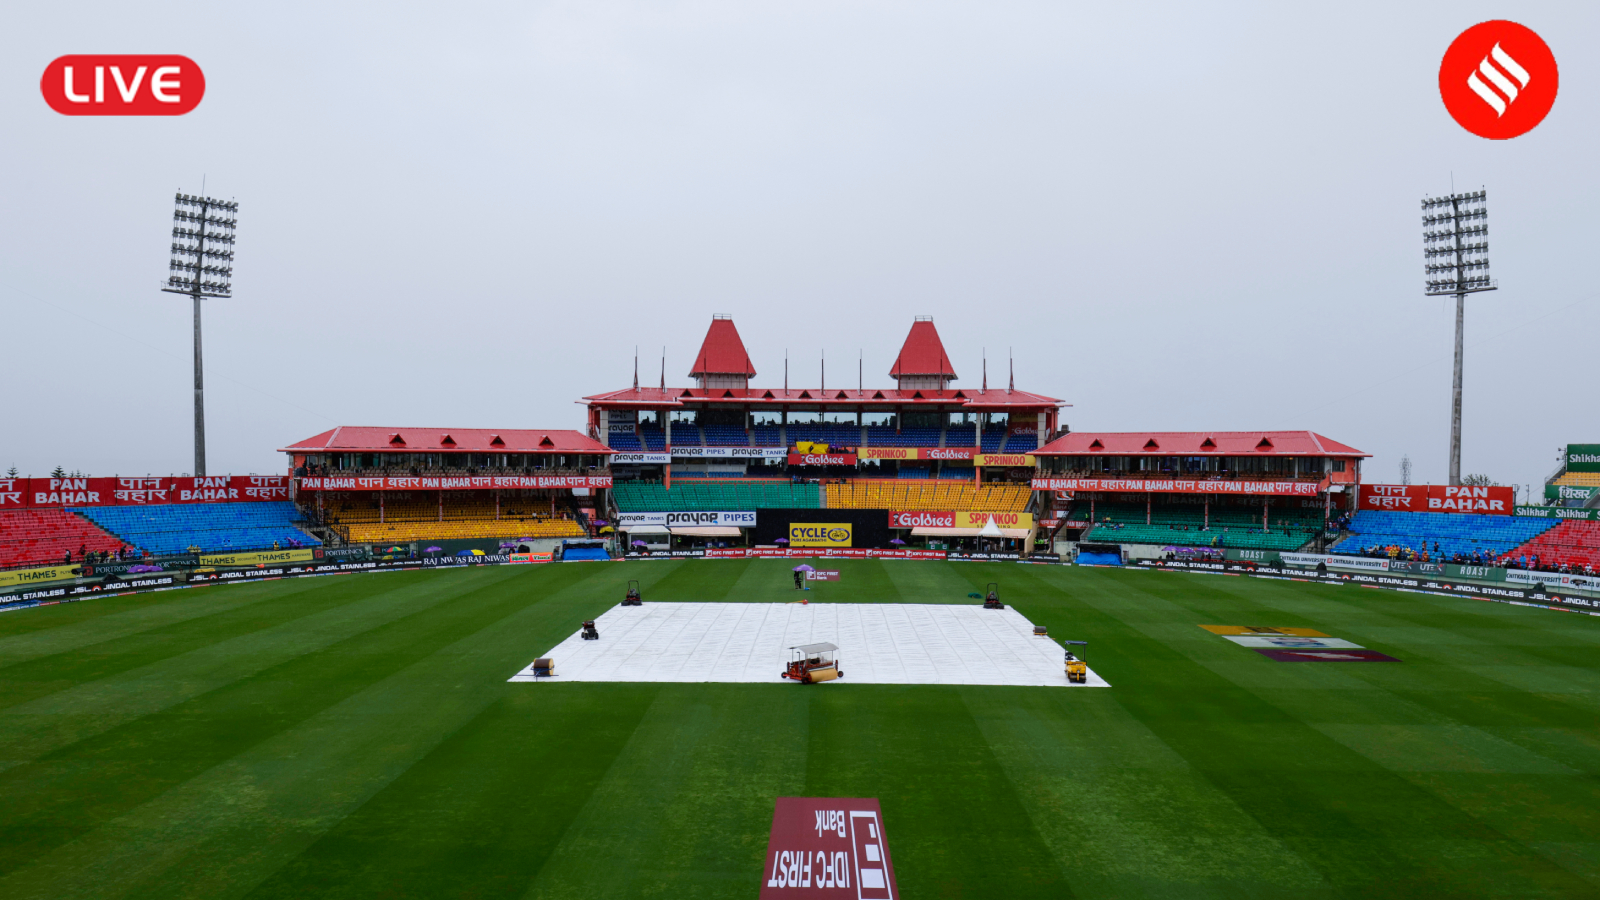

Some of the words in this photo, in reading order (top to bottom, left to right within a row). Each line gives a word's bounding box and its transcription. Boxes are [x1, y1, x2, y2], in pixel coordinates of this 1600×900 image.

[608, 424, 634, 433] rayag
[671, 447, 703, 457] prayag
[732, 448, 763, 457] prayag
[866, 449, 907, 458] SPRINKOO
[614, 454, 644, 462] prayag
[983, 455, 1026, 465] SPRINKOO
[1569, 454, 1600, 463] Shikha
[50, 479, 87, 490] PAN
[119, 478, 162, 489] पान
[193, 477, 226, 488] PAN
[250, 476, 283, 487] पान
[302, 477, 321, 488] PAN
[323, 478, 356, 488] BAHAR
[358, 477, 384, 487] पान
[387, 477, 420, 488] बहार
[422, 478, 439, 488] PAN
[441, 477, 471, 488] BAHAR
[471, 477, 491, 487] पान
[494, 477, 519, 487] बहार
[520, 477, 537, 487] PAN
[538, 477, 566, 487] BAHAR
[567, 477, 586, 486] पान
[588, 477, 612, 487] बहार
[1032, 479, 1048, 489] PAN
[1049, 479, 1078, 489] BAHAR
[1078, 479, 1099, 489] पान
[1101, 480, 1126, 489] बहार
[1126, 480, 1143, 490] PAN
[1144, 480, 1174, 490] BAHAR
[1175, 480, 1195, 490] पान
[1198, 480, 1224, 491] बहार
[1224, 482, 1242, 491] PAN
[1243, 482, 1275, 492] BAHAR
[245, 486, 287, 498] बहार
[1275, 482, 1292, 492] पान
[1294, 483, 1317, 493] बहार
[1373, 485, 1408, 496] पान
[1445, 486, 1488, 498] PAN
[35, 491, 101, 504] BAHAR
[113, 489, 168, 501] बहार
[180, 488, 239, 500] BAHAR
[1368, 496, 1412, 507] बहार
[1428, 498, 1504, 511] BAHAR
[1516, 507, 1549, 517] Shikhar
[1555, 508, 1590, 519] Shikhar
[666, 512, 718, 525] prayag
[791, 528, 827, 537] CYCLE
[325, 548, 363, 557] PORTRONICS
[1239, 550, 1265, 559] ROAST
[202, 556, 235, 565] THAMES
[257, 553, 291, 561] THAMES
[423, 557, 438, 566] RAJ
[468, 555, 482, 563] RAJ
[484, 554, 510, 563] NIWAS
[1333, 558, 1355, 566] CHITKARA
[1355, 560, 1382, 568] UNIVERSITY
[340, 562, 376, 570] STAINLESS
[1189, 562, 1224, 570] STAINLESS
[1460, 566, 1489, 576] ROAST
[17, 569, 57, 581] THAMES
[219, 571, 245, 579] JINDAL
[245, 568, 283, 577] STAINLESS
[1506, 572, 1530, 580] CHITKARA
[1531, 574, 1562, 583] UNIVERSITY
[103, 582, 131, 590] JINDAL
[132, 577, 173, 588] STAINLESS
[1378, 577, 1418, 587] STAINLESS
[0, 594, 21, 603] NDAL
[23, 589, 65, 600] STAINLESS
[1453, 585, 1480, 593] JINDAL
[1482, 588, 1524, 598] STAINLESS
[1562, 597, 1591, 606] JINDAL
[814, 810, 847, 838] Bank
[767, 850, 812, 889] FIRST
[816, 850, 850, 889] IDFC
